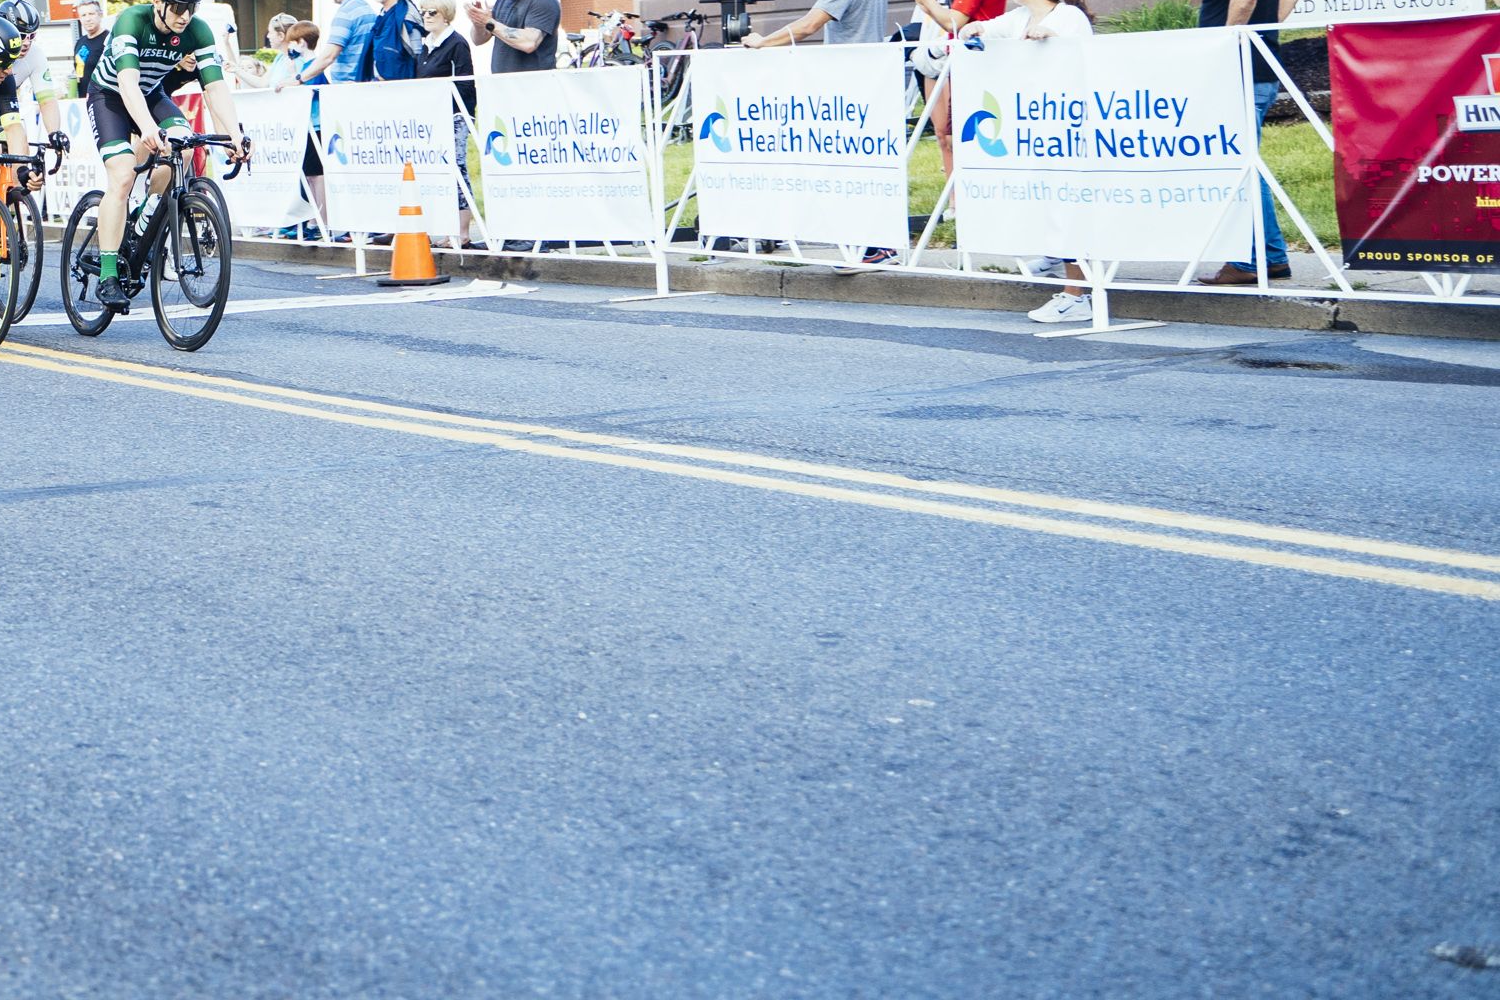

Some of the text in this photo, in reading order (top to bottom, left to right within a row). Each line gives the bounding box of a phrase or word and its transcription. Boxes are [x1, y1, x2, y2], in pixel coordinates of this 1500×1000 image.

[140, 48, 183, 61] VESELKA
[737, 95, 869, 129] Lehigh Valley
[1094, 89, 1188, 127] Valley
[263, 121, 296, 145] Valley
[349, 119, 433, 144] Lehigh Valley
[513, 112, 620, 141] Lehigh Valley
[516, 140, 638, 165] Health Network
[738, 127, 898, 156] Health Network
[1016, 124, 1241, 158] Health Network
[351, 145, 448, 165] Health Network
[700, 173, 725, 190] Your
[729, 172, 770, 191] health
[835, 181, 843, 194] a
[962, 179, 998, 200] Your
[1002, 180, 1051, 201] health
[1139, 187, 1152, 204] a
[1359, 251, 1494, 263] PROUD SPONSOR OF
